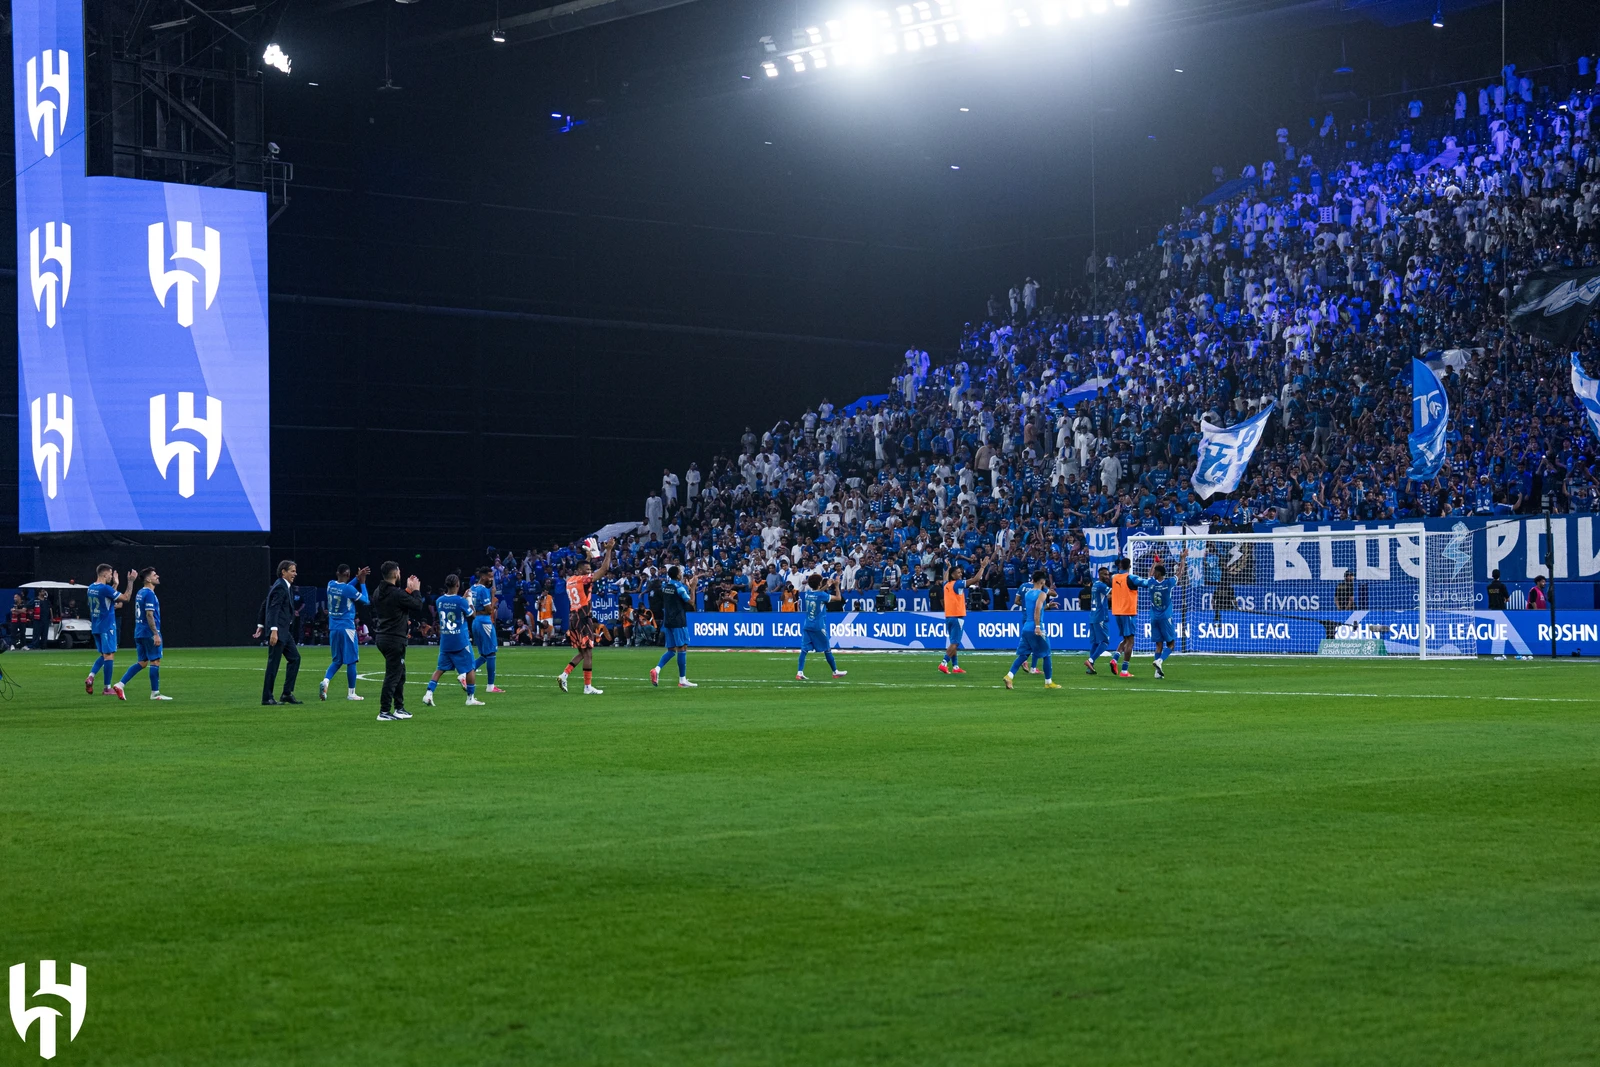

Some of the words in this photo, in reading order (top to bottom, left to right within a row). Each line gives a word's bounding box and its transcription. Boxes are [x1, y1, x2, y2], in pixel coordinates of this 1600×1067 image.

[1201, 593, 1255, 610] flas
[1264, 593, 1320, 610] flynas
[592, 610, 613, 623] Riyad
[694, 622, 729, 637] ROSHN
[733, 622, 764, 637] SAUDI
[829, 623, 867, 637] ROSHN
[873, 623, 906, 637] SAUDI
[978, 622, 1020, 638] ROSHN
[1198, 622, 1239, 639] SAUDI
[1389, 623, 1435, 640] SAUDI
[1449, 623, 1508, 640] LEAGUE
[1538, 624, 1598, 641] ROSHN
